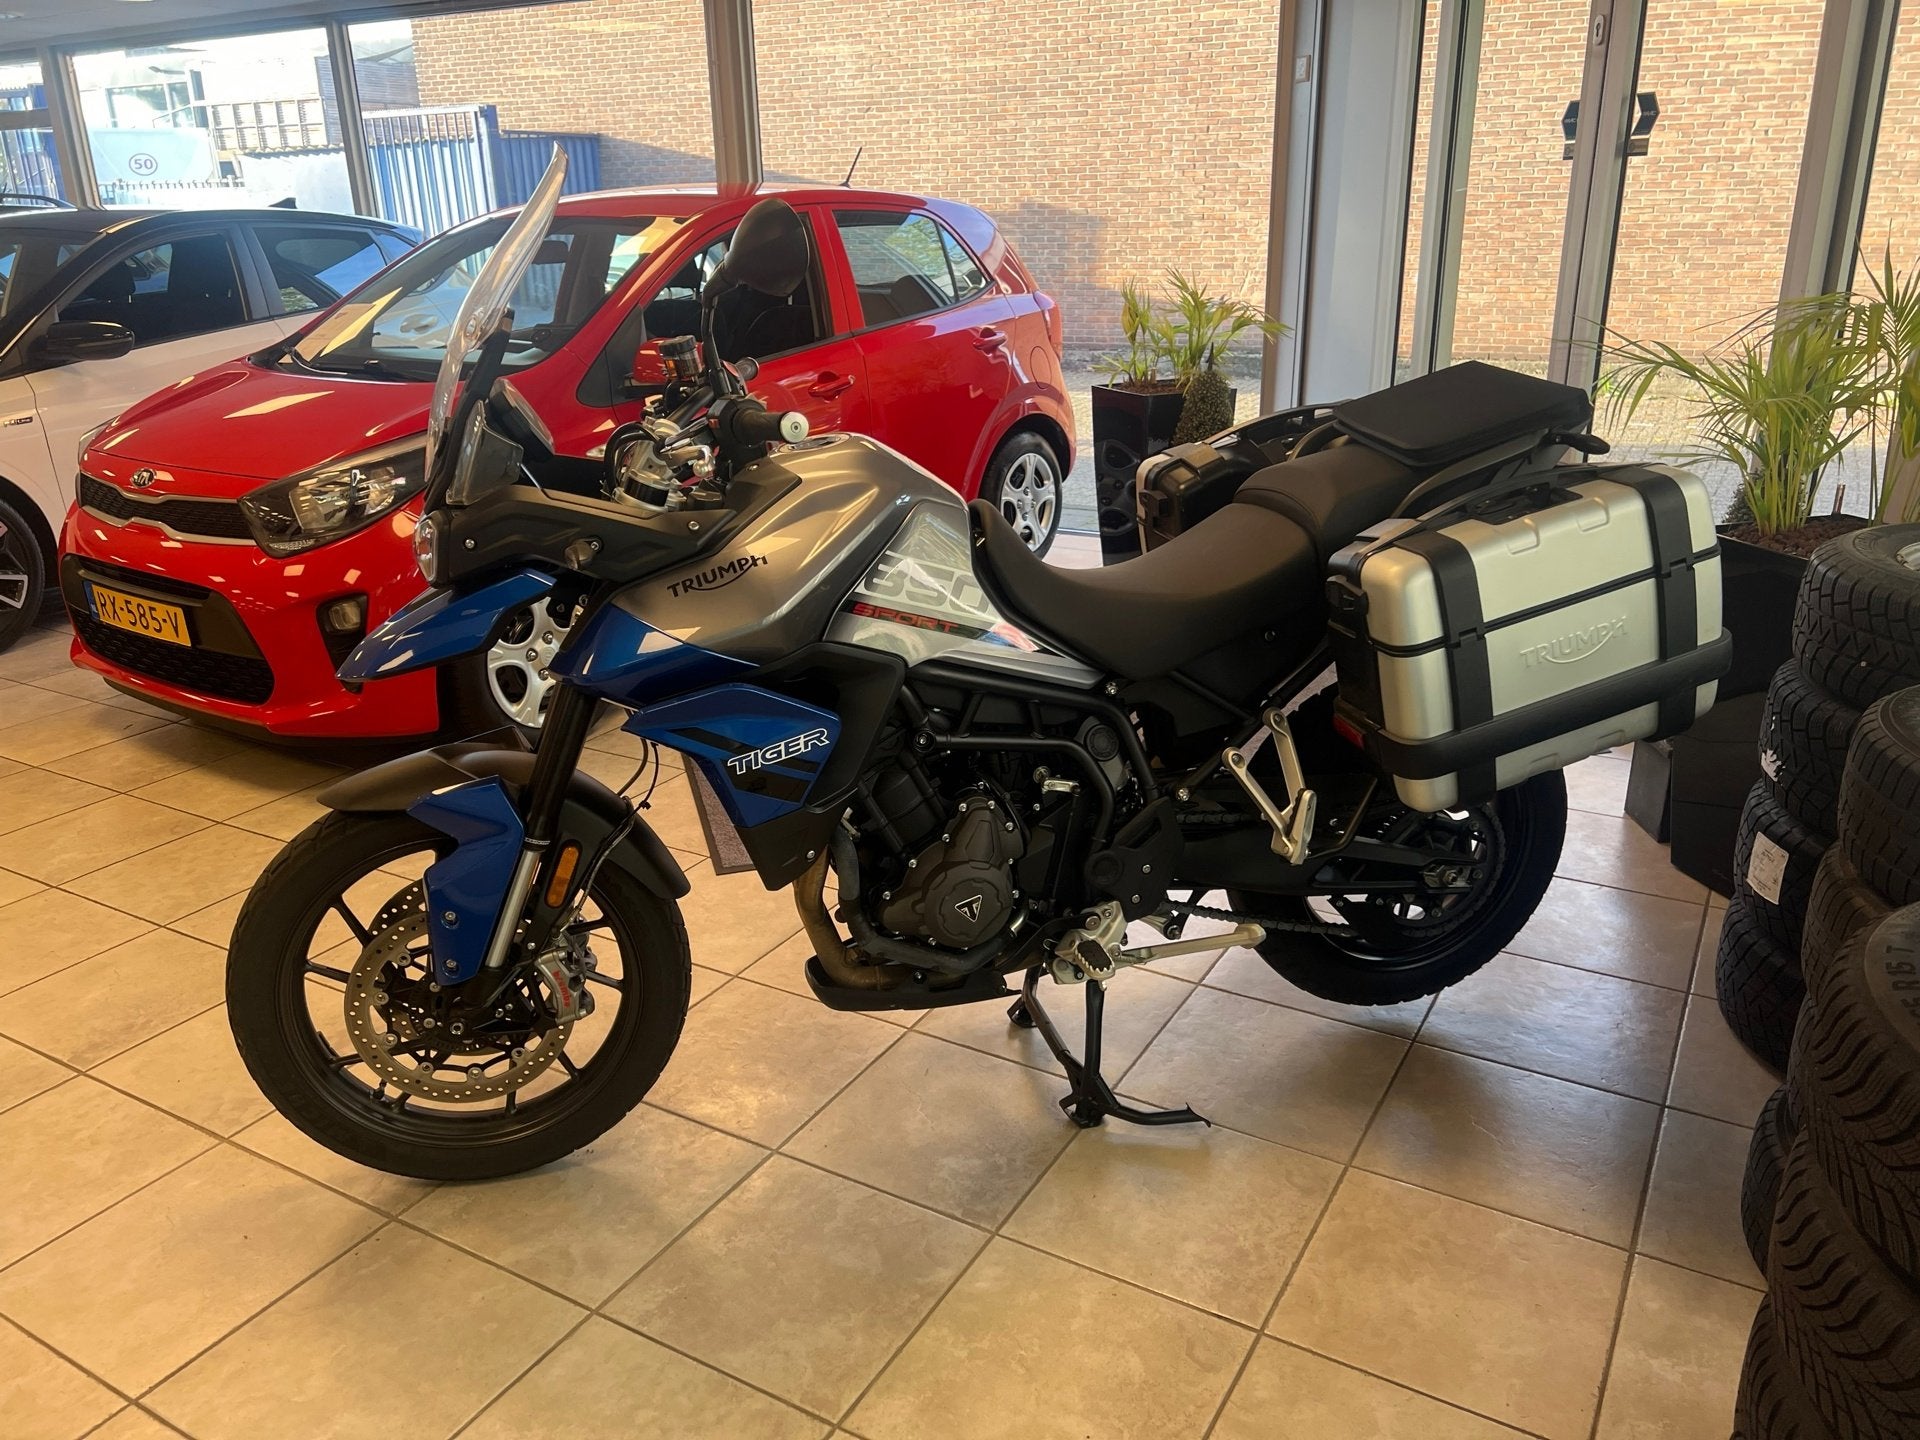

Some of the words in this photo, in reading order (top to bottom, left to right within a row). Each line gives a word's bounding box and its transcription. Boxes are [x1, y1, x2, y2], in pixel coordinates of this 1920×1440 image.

[134, 158, 153, 170] 50
[666, 555, 768, 598] TRIUMPH
[861, 551, 990, 614] 850
[97, 591, 180, 638] RX-585-V
[852, 600, 959, 633] SPORT
[1520, 615, 1629, 669] TRIUMPH
[727, 728, 830, 775] TIGER
